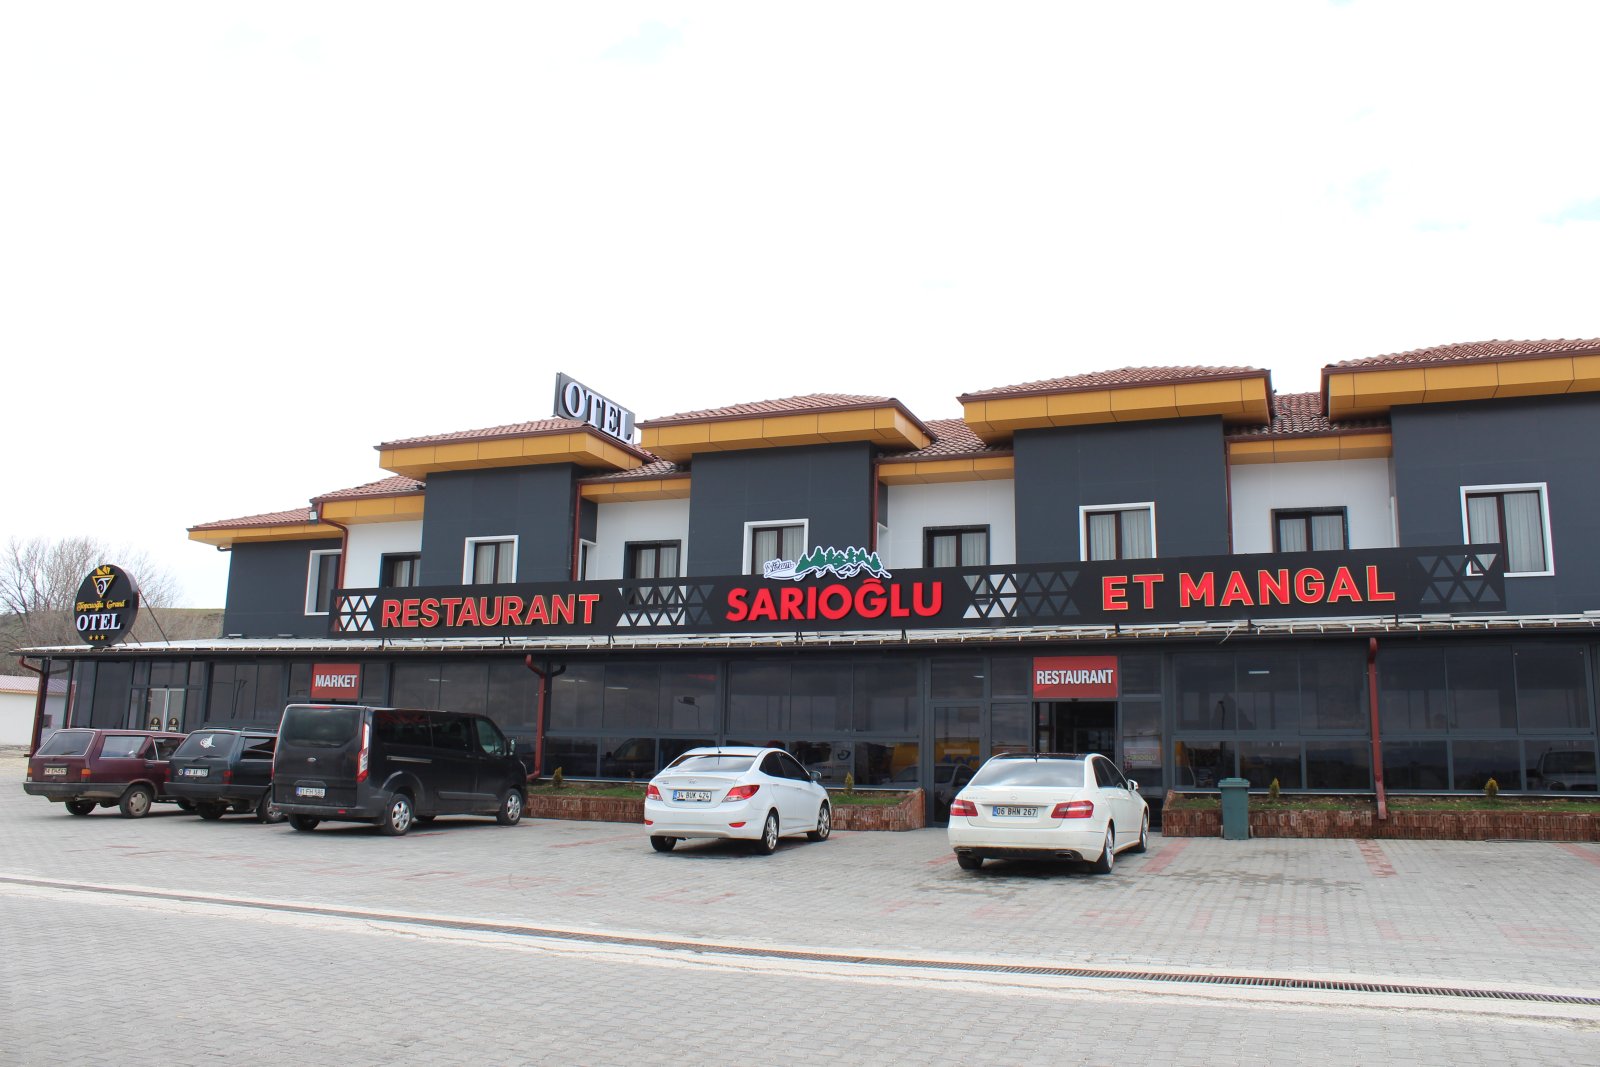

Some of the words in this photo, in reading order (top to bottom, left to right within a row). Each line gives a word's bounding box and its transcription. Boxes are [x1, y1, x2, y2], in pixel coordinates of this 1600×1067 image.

[562, 381, 634, 445] OTEL
[725, 578, 943, 622] SARIOĞLU
[1102, 574, 1164, 611] ET
[1179, 565, 1396, 608] MANGAL
[76, 613, 121, 632] OTEL
[381, 593, 600, 628] RESTAURANT
[314, 674, 358, 688] MARKET
[1036, 669, 1114, 685] RESTAURANT
[997, 807, 1005, 815] 06
[1023, 808, 1037, 816] 267
